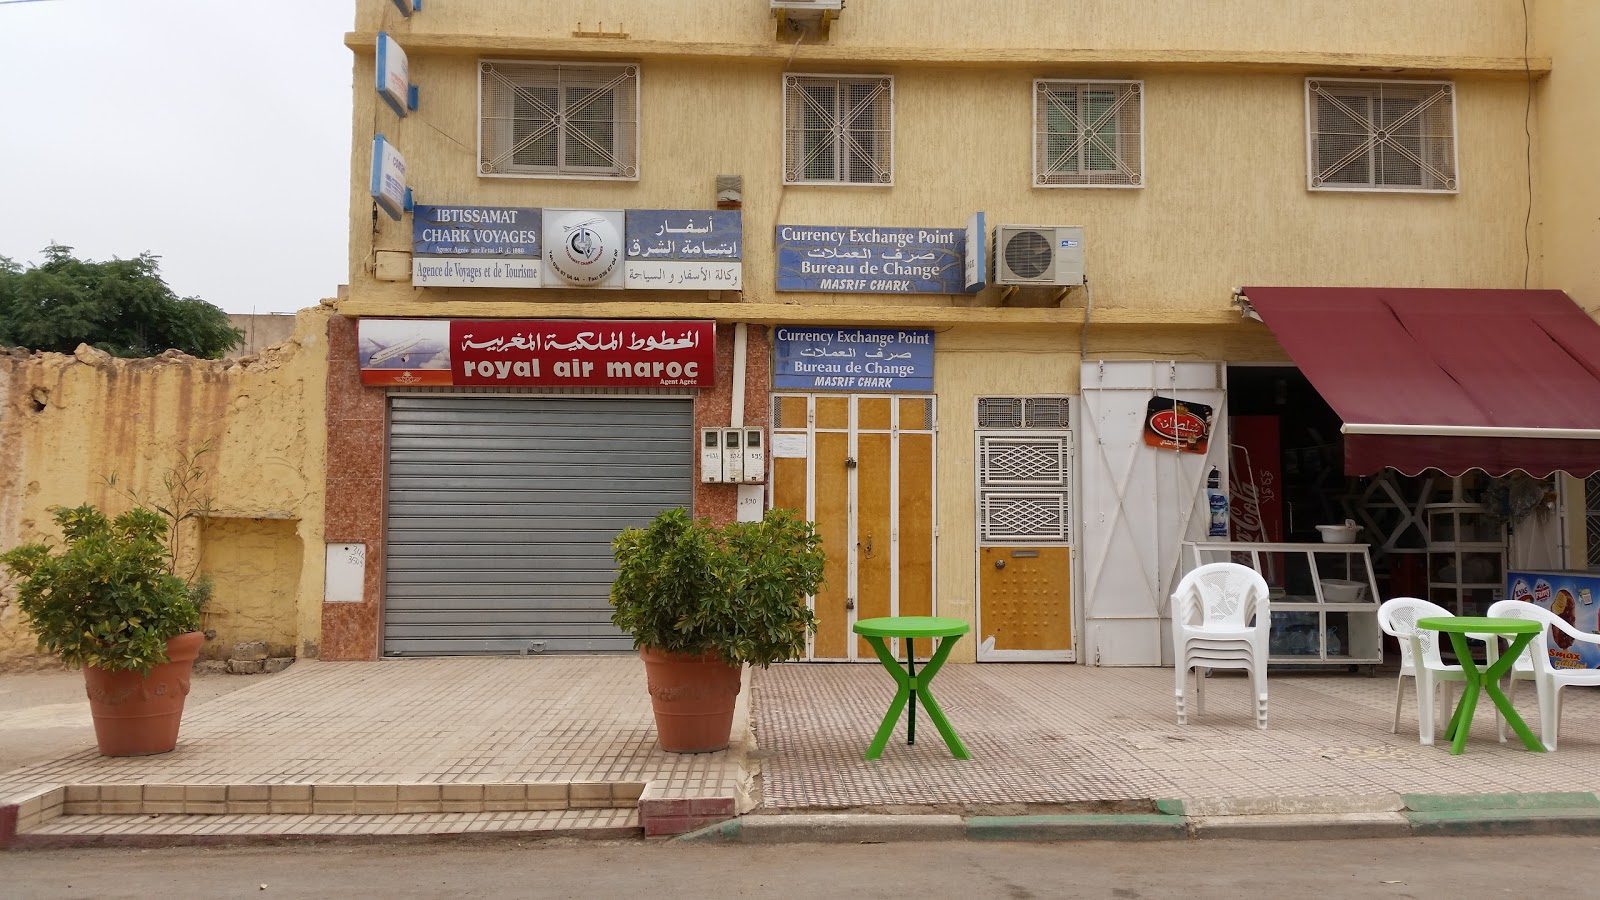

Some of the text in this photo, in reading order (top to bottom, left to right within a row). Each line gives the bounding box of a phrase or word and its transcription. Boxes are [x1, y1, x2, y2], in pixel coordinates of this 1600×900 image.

[437, 210, 518, 224] IBTISSAMAT
[656, 216, 713, 236] أسفار
[422, 228, 536, 244] CHARK VOYAGES
[782, 228, 845, 246] Currency
[850, 230, 913, 248] Exchange
[918, 231, 954, 244] Point
[628, 239, 675, 257] الشرق
[808, 248, 935, 262] صرف العملات
[417, 262, 537, 282] Agence de Voyages et de Tourisme
[629, 266, 738, 286] وكالة الأسفار و السياحة
[802, 262, 940, 278] Bureau de Change
[820, 279, 910, 291] MASRIF CHARK
[461, 330, 699, 352] الخطوط الملكية المغربية
[778, 329, 930, 347] Currency Exchange Point
[800, 347, 912, 360] صرف العملات
[464, 358, 698, 379] royal air maroc
[794, 362, 914, 377] Bureau de Change
[815, 376, 892, 388] MASRIF CHARK
